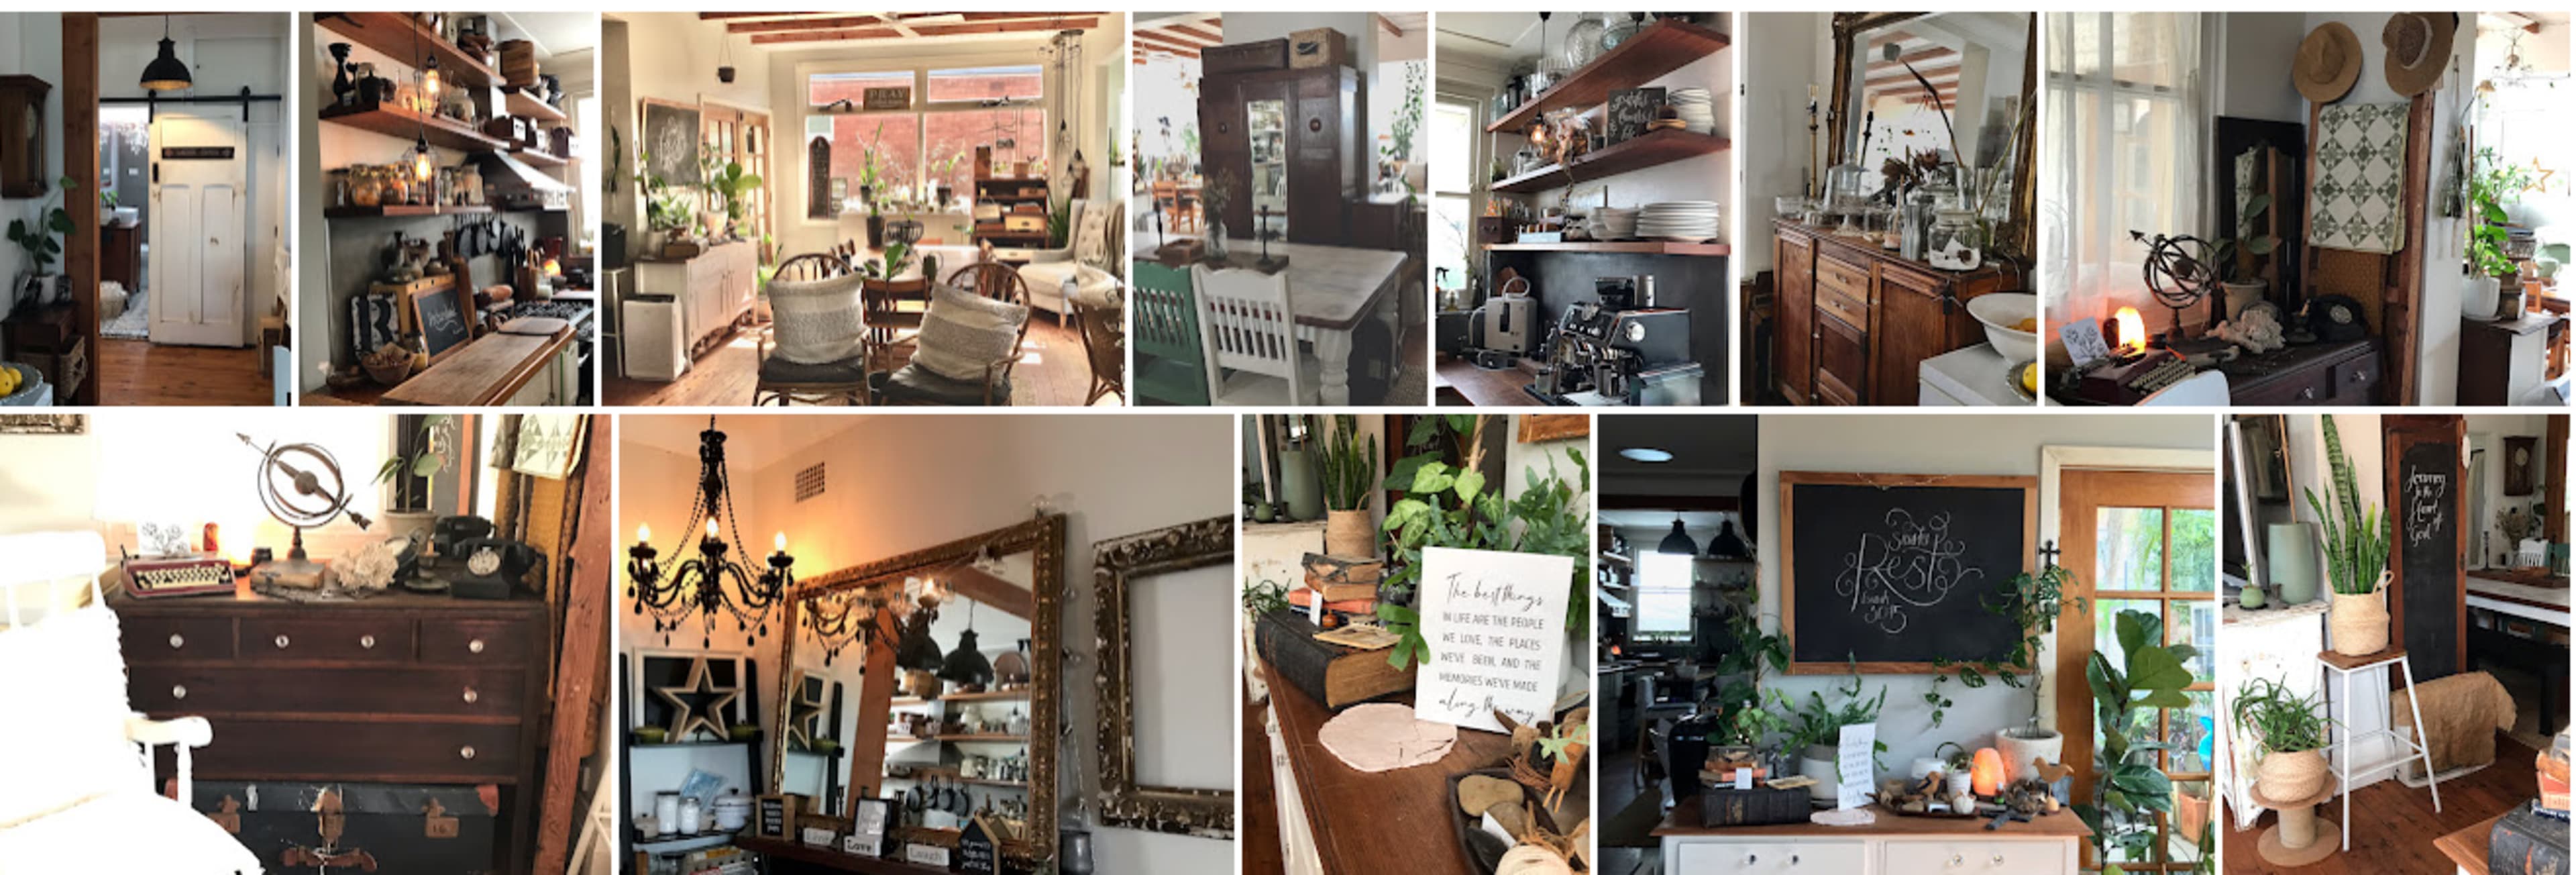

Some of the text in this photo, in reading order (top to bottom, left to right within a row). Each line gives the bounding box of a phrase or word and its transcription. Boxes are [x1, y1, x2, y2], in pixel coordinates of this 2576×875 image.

[2405, 465, 2446, 499] Journey
[2410, 523, 2431, 548] God
[1836, 520, 1969, 612] Rest
[1446, 572, 1543, 611] The best things
[1443, 611, 1544, 630] IN LIFE ARE THE PEOPLE
[1442, 633, 1455, 644] WE
[1489, 636, 1505, 648] THE
[1509, 637, 1542, 652] PLACES
[1501, 657, 1520, 669] AND
[1525, 660, 1542, 670] THE
[1439, 672, 1483, 686] MEMORIES
[1512, 681, 1538, 692] MADE
[1439, 688, 1480, 718] along
[1505, 708, 1536, 724] way
[847, 839, 872, 851] Love
